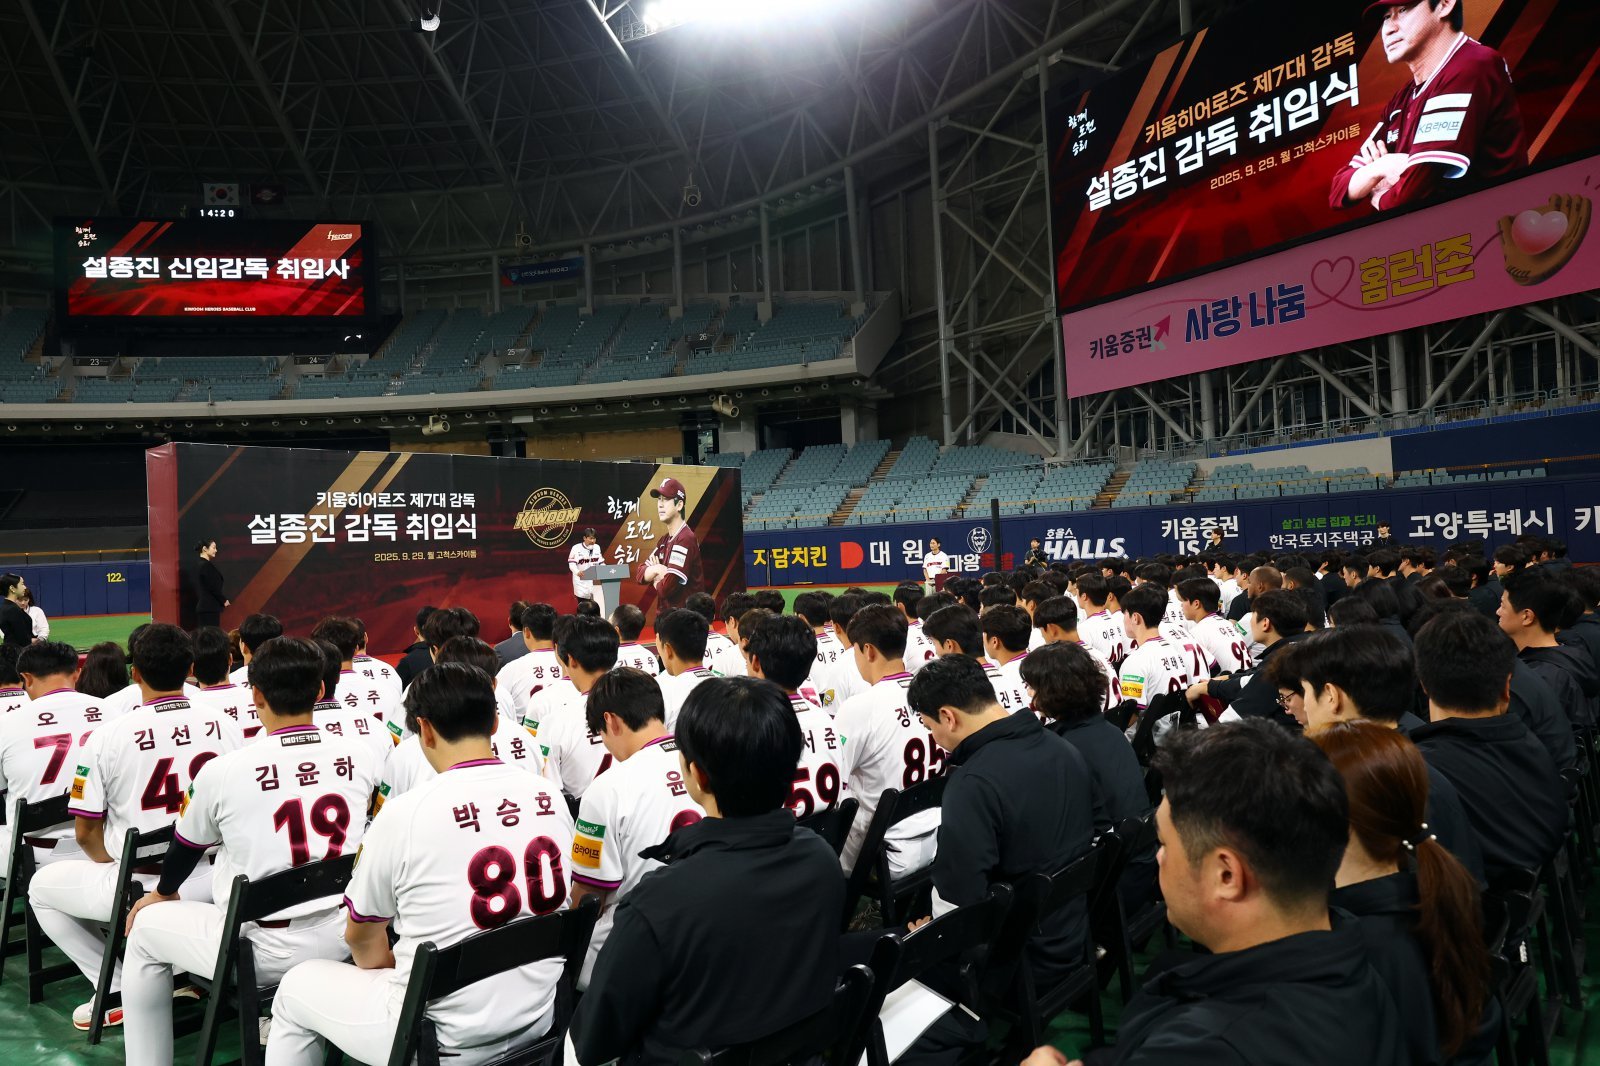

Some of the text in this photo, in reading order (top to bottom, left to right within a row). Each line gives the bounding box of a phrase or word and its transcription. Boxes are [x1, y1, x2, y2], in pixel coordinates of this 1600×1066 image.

[1145, 31, 1355, 143] 키움히어로즈 제7대 감독
[1078, 118, 1097, 138] 도전
[1085, 63, 1360, 212] 설종진 감독 취임식
[1417, 121, 1460, 133] KB라이프
[1072, 139, 1088, 156] 승리
[1210, 169, 1243, 190] 2025.
[1258, 156, 1278, 172] 29.
[1293, 122, 1361, 159] 고척스카이돔
[200, 209, 234, 217] 14:20
[82, 256, 351, 280] 설종진 신임감독 취임사
[1185, 233, 1475, 343] 사랑 나눔 홈런존
[1089, 325, 1152, 360] 키움증권
[316, 492, 476, 508] 키움히어로즈 제7대 감독
[607, 495, 640, 520] 함께
[247, 513, 477, 544] 설종진 감독 취임식
[513, 507, 582, 531] KIWOOM
[625, 520, 655, 540] 도전
[1161, 515, 1239, 540] 키움증권
[1408, 506, 1554, 540] 고양특례시
[1269, 530, 1378, 550] 한국토지주택공
[436, 550, 477, 559] 고척스카이돔
[614, 544, 640, 565] 승리
[753, 546, 828, 569] 자담치킨
[784, 762, 841, 821] 59
[273, 793, 351, 868] 19
[467, 835, 567, 930] 80
